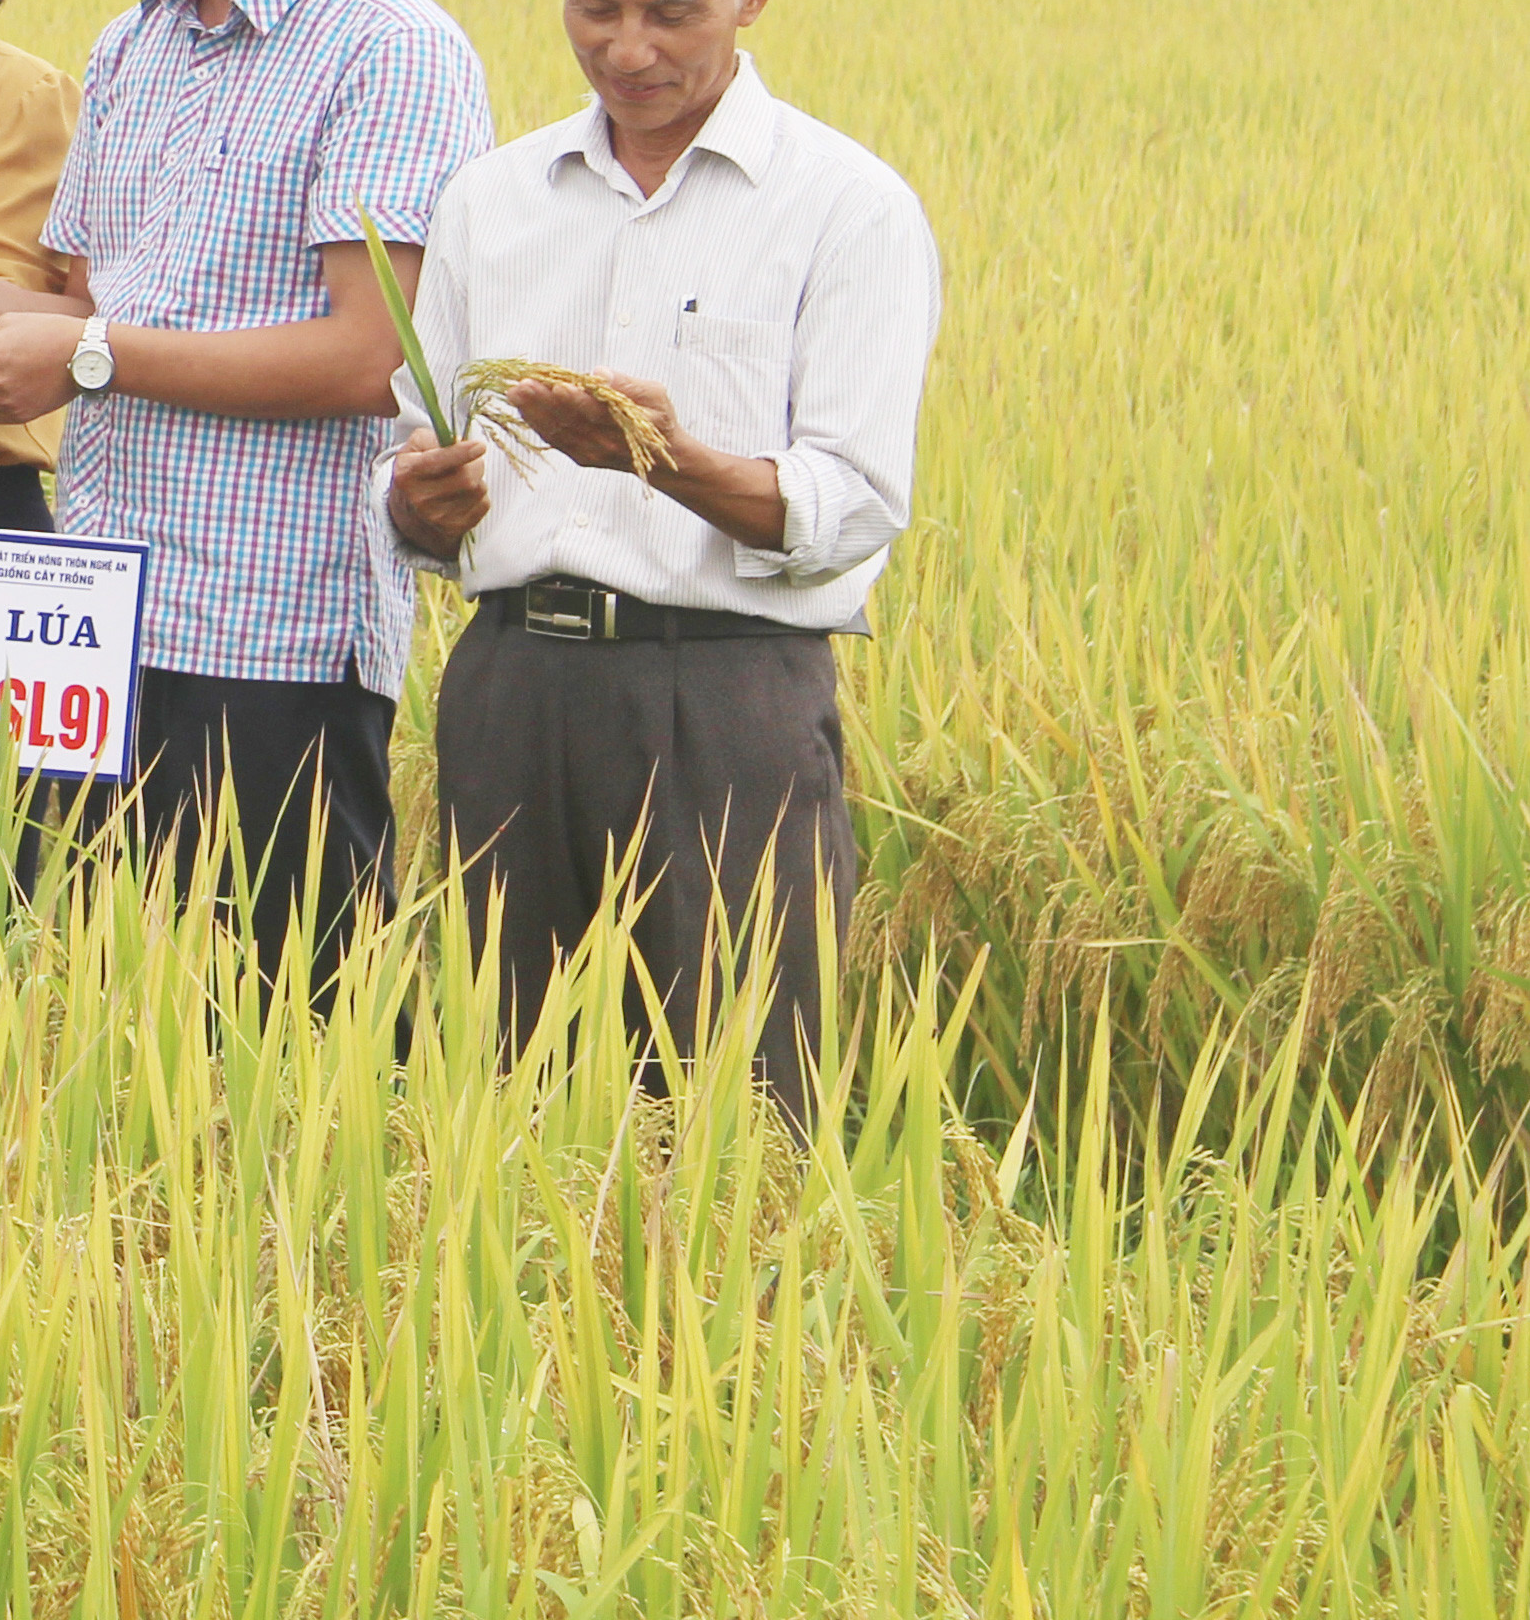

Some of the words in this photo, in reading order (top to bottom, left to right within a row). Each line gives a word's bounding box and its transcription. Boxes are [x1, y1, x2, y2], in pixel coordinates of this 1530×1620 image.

[38, 554, 62, 566] NÔNG
[65, 556, 88, 569] THÔN
[115, 562, 128, 572] AN
[34, 570, 56, 582] CÂY
[6, 604, 101, 648] LÚA
